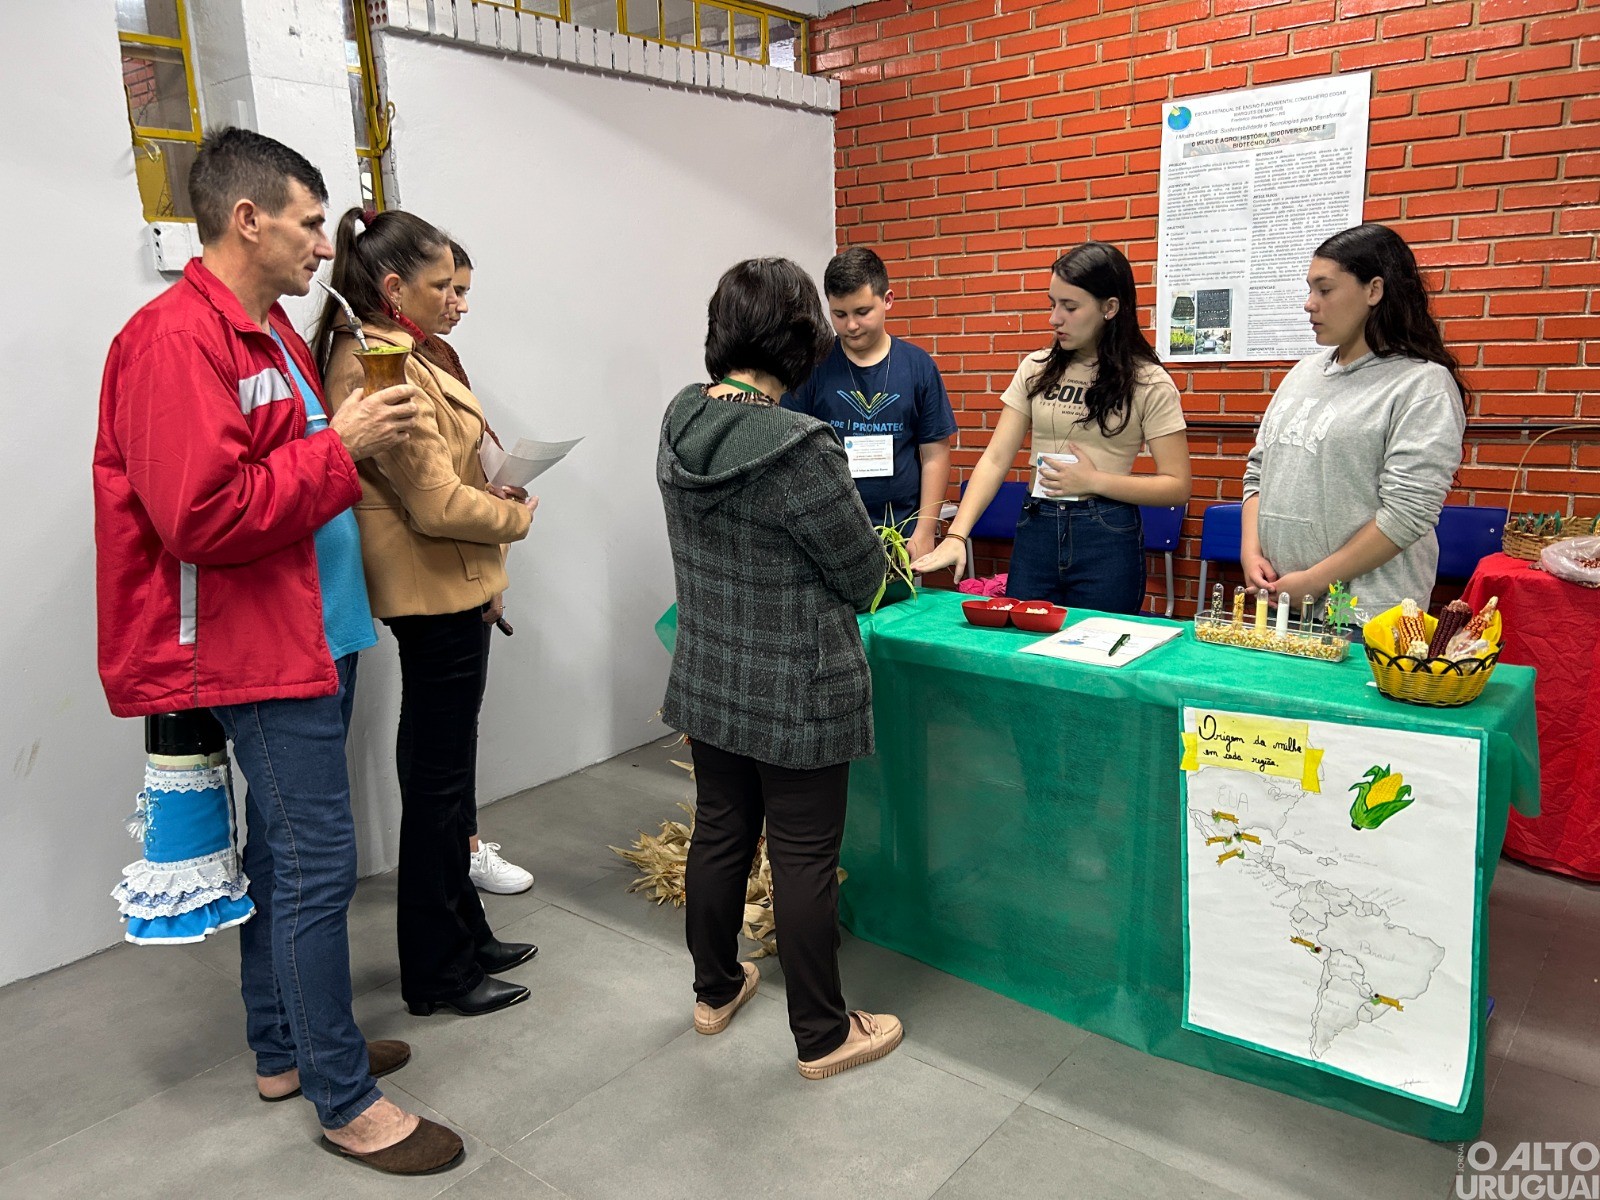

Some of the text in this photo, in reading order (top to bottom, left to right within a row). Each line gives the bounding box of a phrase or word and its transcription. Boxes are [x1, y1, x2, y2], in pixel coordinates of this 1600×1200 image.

[1300, 116, 1314, 124] para
[1270, 125, 1322, 137] BIODIVERSIDADE
[1232, 138, 1281, 148] BIOTECNOLOGIA
[852, 422, 904, 432] PRONATEC
[1198, 714, 1245, 752] Origem
[1203, 749, 1218, 757] em
[1223, 752, 1243, 761] cada
[1217, 784, 1250, 812] EUA
